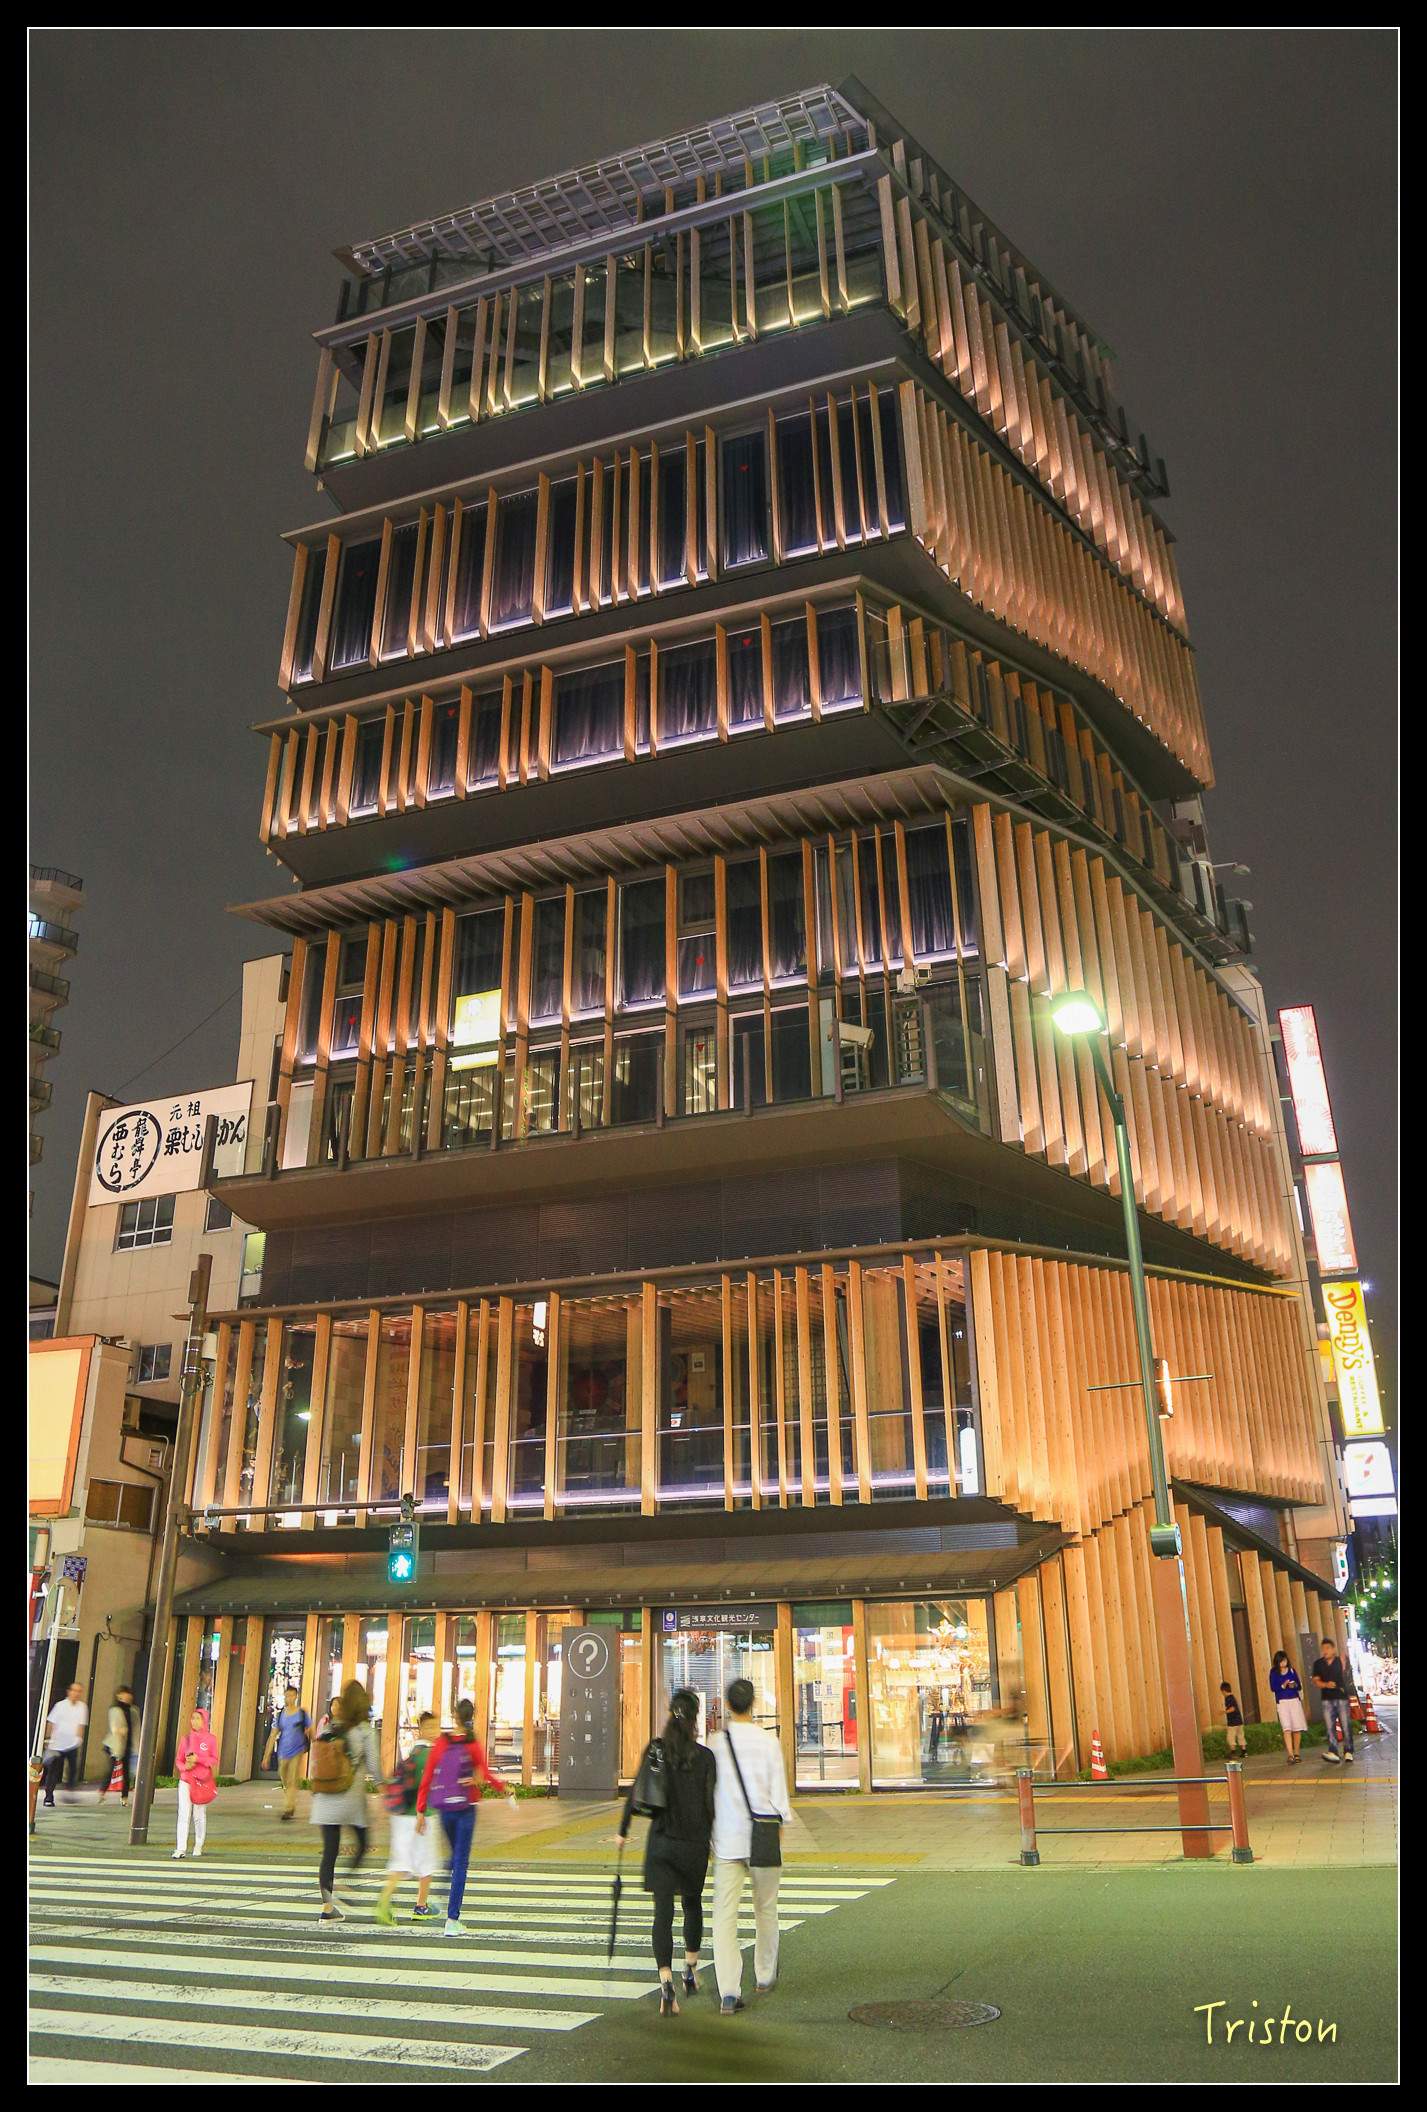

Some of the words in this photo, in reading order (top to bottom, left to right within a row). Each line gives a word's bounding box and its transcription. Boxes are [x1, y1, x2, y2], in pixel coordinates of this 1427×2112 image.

[164, 1115, 246, 1156] 栗むしかん
[169, 1101, 201, 1122] 元祖
[109, 1122, 129, 1184] 西むら
[1327, 1287, 1370, 1370] Denny's
